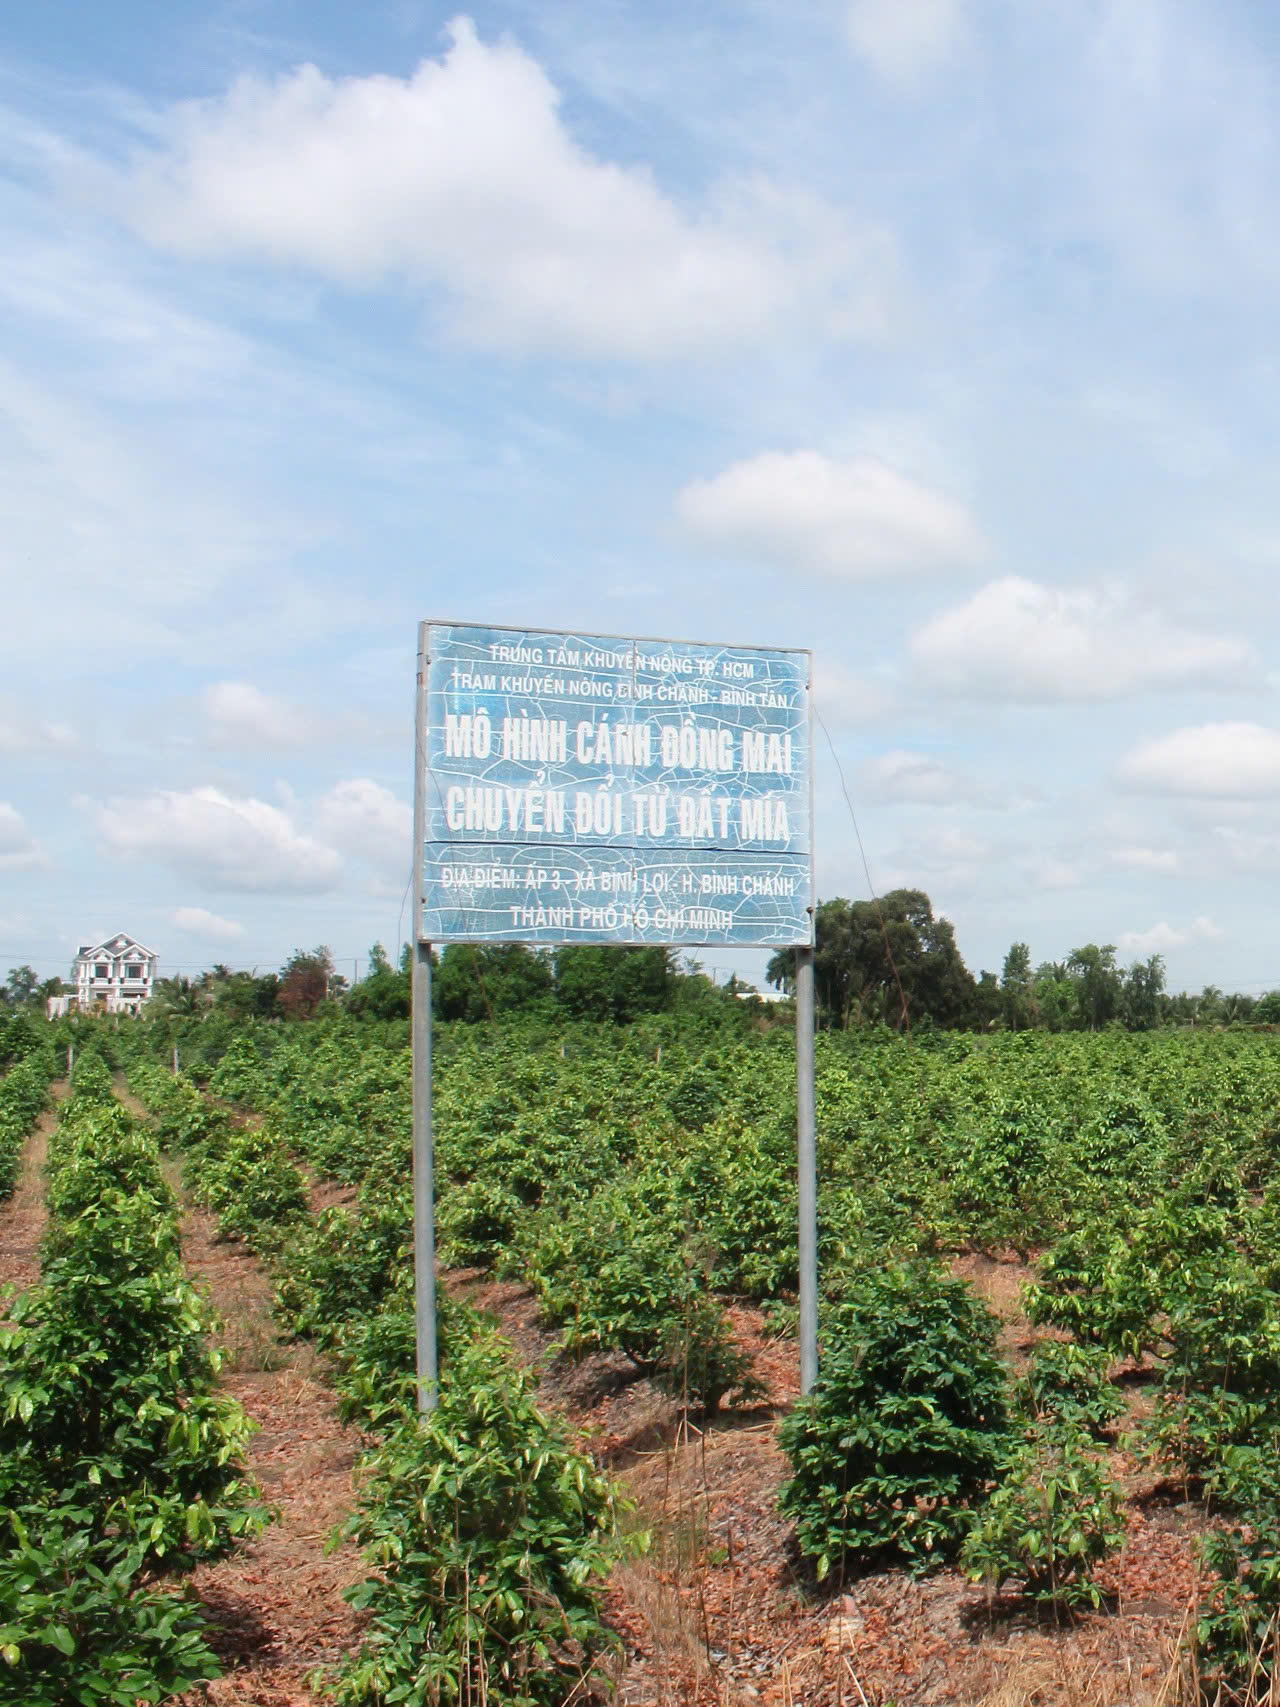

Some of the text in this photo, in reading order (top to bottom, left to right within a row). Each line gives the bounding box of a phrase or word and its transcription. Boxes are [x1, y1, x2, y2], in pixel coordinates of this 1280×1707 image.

[489, 645, 543, 664] TRUNG
[548, 646, 580, 666] TÂM
[650, 653, 693, 674] NÔNG
[723, 661, 754, 679] HCM
[452, 671, 497, 692] TRẠM
[501, 673, 565, 695] KHUYẾN
[569, 677, 613, 698] NÔNG
[720, 687, 755, 706] BÌNH
[759, 689, 787, 708] TÂN
[446, 707, 792, 774] MÔ HÌNH CÁNH ĐỒNG MAI
[446, 770, 565, 833] CHUYỂN
[576, 773, 622, 835] ĐỔI
[679, 782, 731, 839] ĐẤT
[441, 867, 469, 892] ĐỊA
[473, 857, 520, 889] ĐIỂM:
[525, 861, 547, 890] ẤP
[552, 870, 561, 890] 3
[702, 870, 738, 895] BÌNH
[742, 872, 794, 896] CHÁNH
[510, 901, 573, 927] THÀNH
[690, 909, 733, 930] MINH
